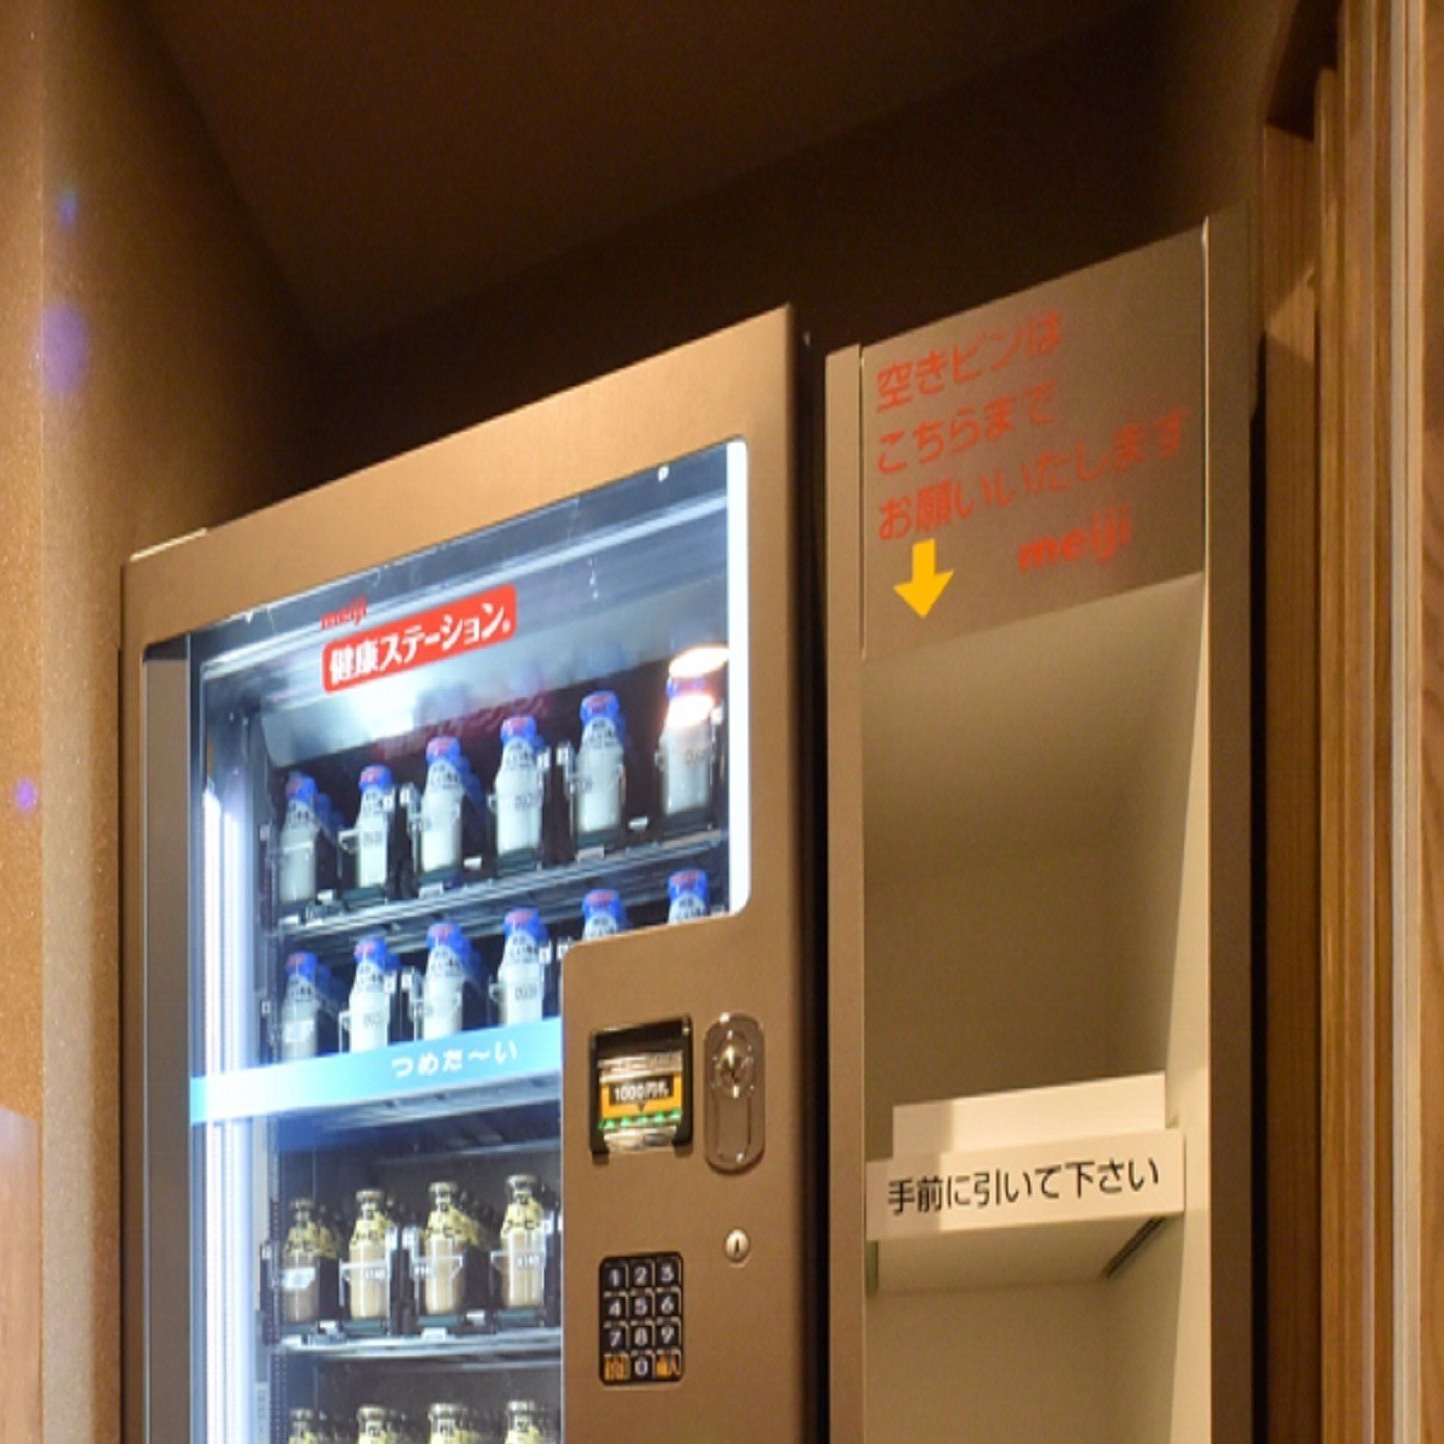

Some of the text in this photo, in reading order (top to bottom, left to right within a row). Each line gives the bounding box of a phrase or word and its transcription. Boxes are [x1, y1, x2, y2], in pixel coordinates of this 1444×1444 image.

[876, 308, 1062, 414] 空きビンは
[876, 380, 1056, 475] こちらまで
[876, 408, 1191, 542] お願いいたします
[1018, 502, 1132, 572] meiji
[887, 1156, 1160, 1216] 手前に引いて下さい
[608, 1295, 675, 1316] 4 5 6
[611, 1264, 674, 1287] 1 2 3
[610, 1325, 675, 1347] 7 8 9
[634, 1355, 648, 1376] 0
